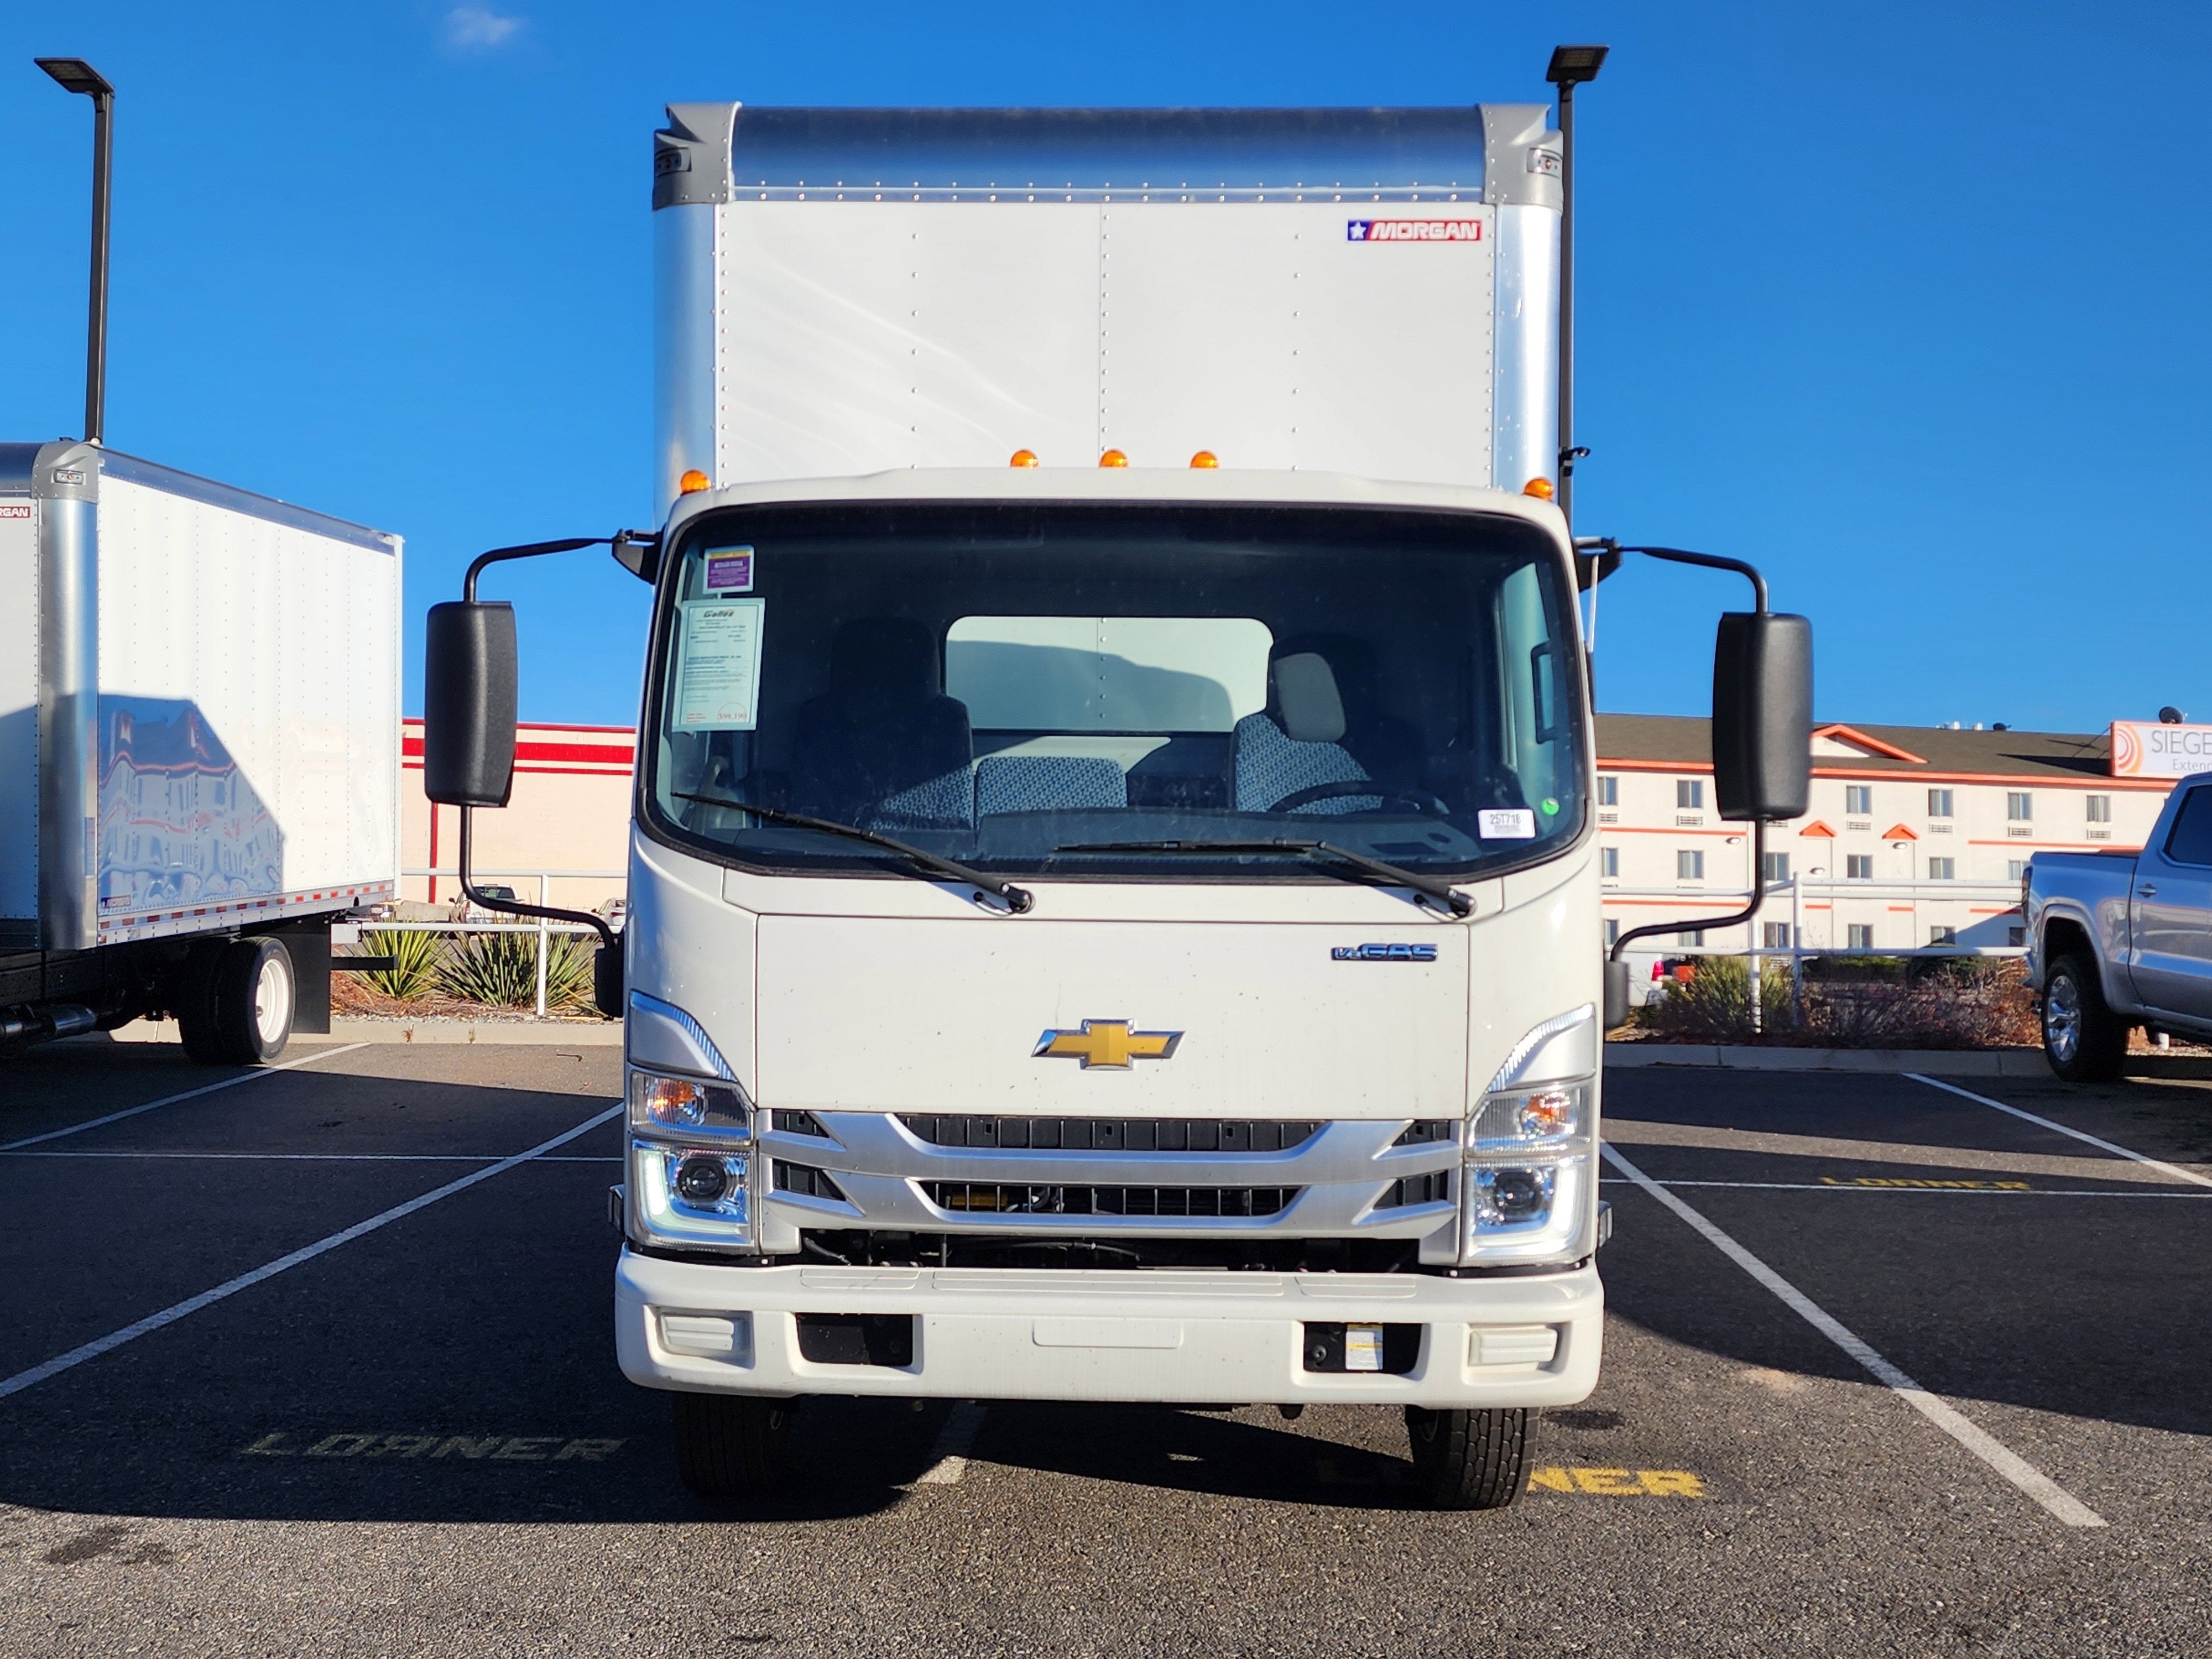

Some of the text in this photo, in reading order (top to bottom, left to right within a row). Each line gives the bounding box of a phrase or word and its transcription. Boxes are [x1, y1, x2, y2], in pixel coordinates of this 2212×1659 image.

[1370, 221, 1478, 240] MORGAN
[2151, 729, 2212, 755] SIEGE
[238, 1431, 630, 1461] LOANER
